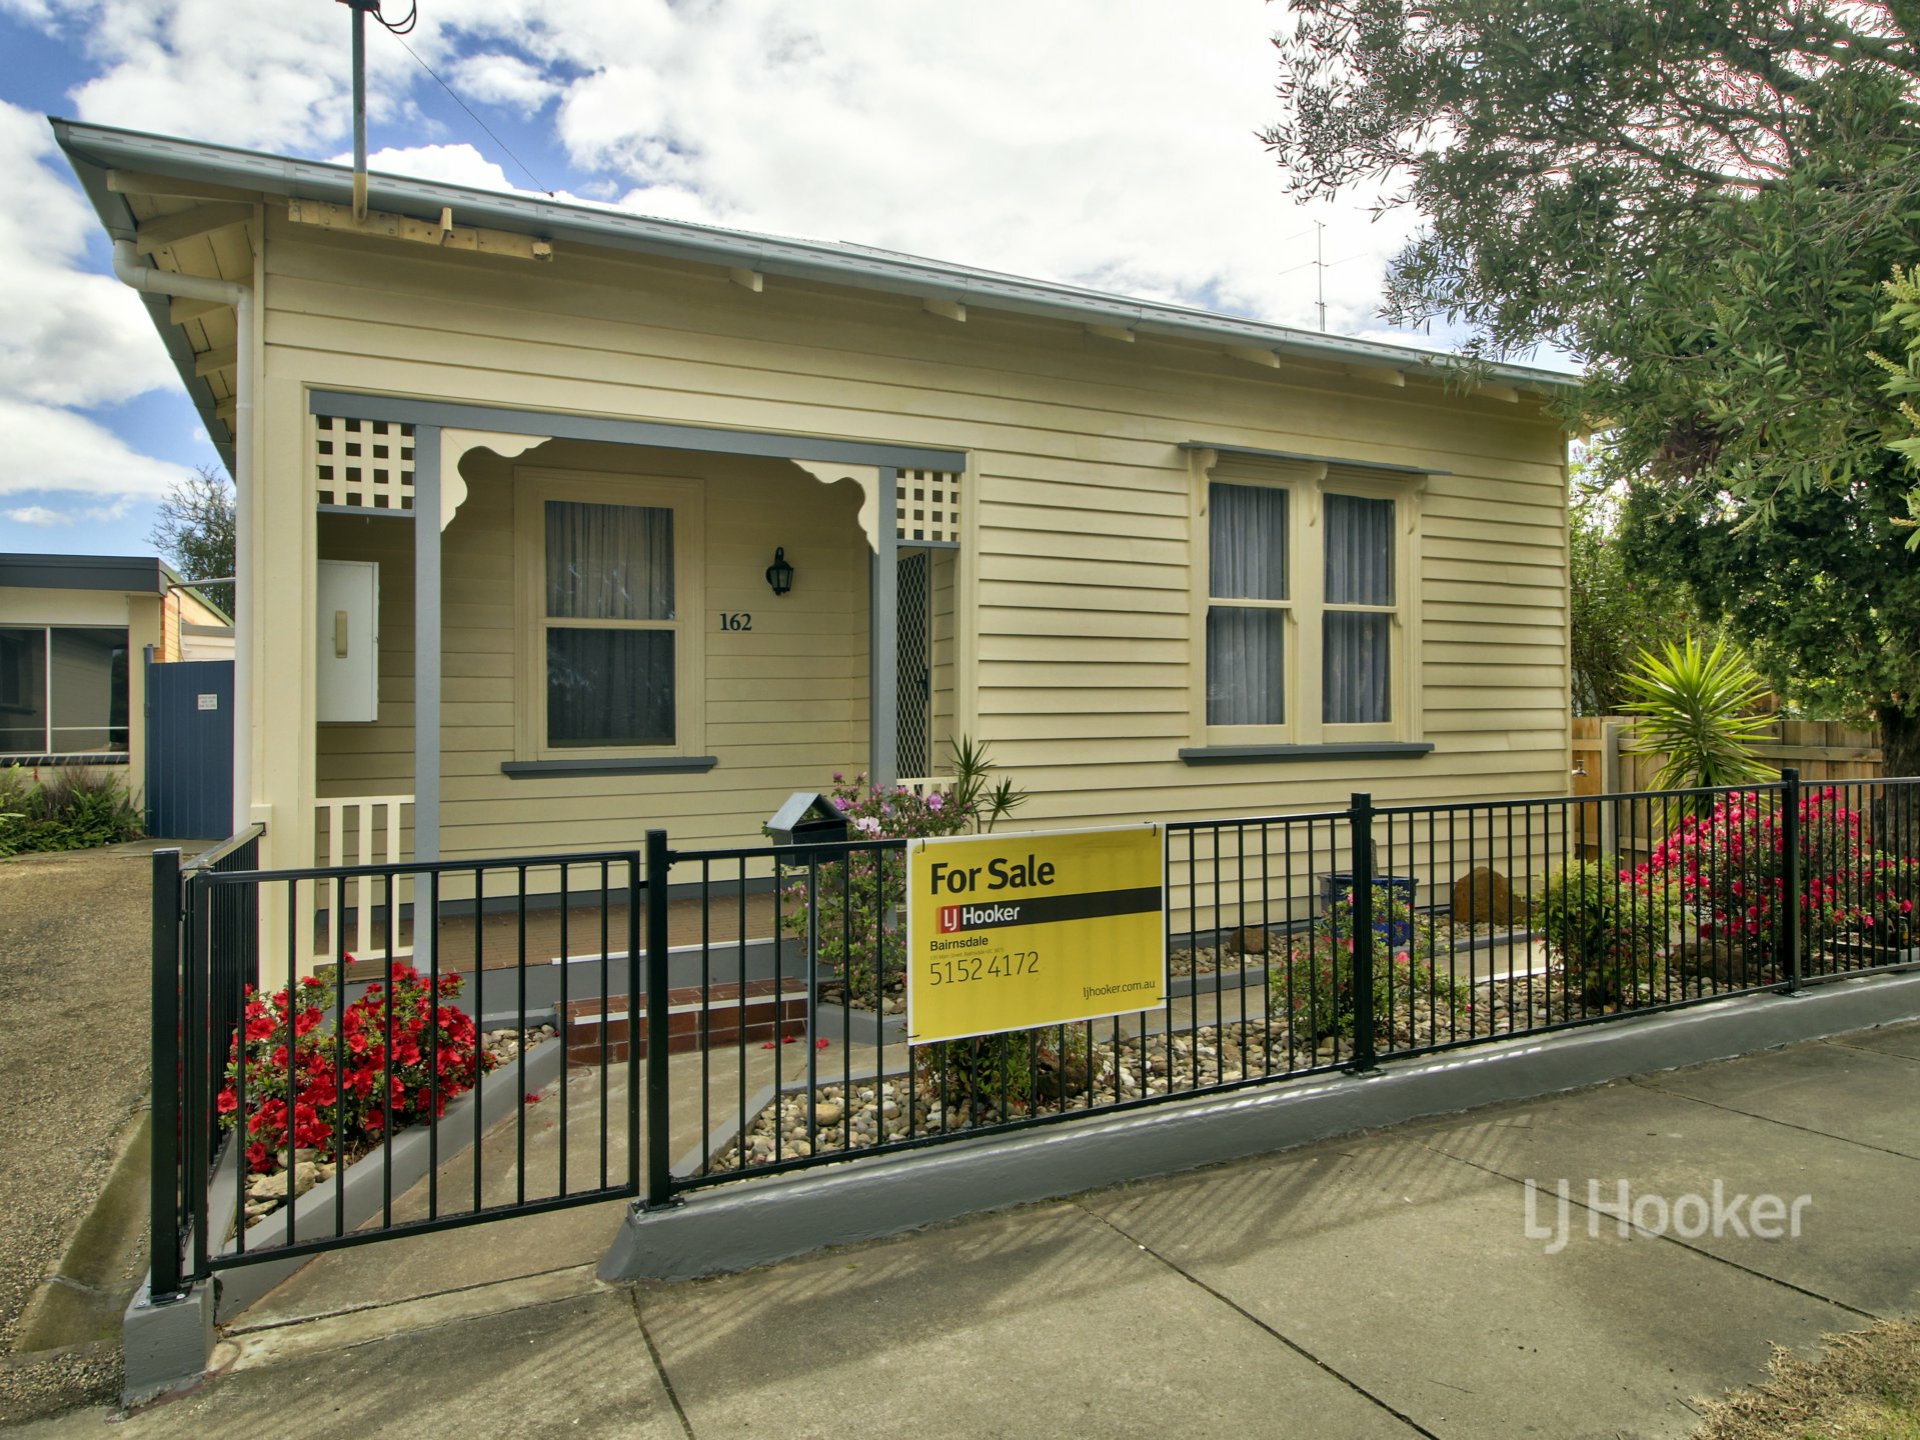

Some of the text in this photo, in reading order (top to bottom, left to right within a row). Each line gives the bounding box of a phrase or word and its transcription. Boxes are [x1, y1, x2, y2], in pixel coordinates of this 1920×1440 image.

[719, 612, 753, 631] 162
[930, 853, 1056, 895] For Sale
[943, 904, 1021, 932] LJ Hooker
[929, 935, 989, 952] Bairnsdale
[930, 957, 983, 986] 5152
[987, 951, 1040, 978] 4172
[1082, 980, 1156, 1001] ljhooker.com.au
